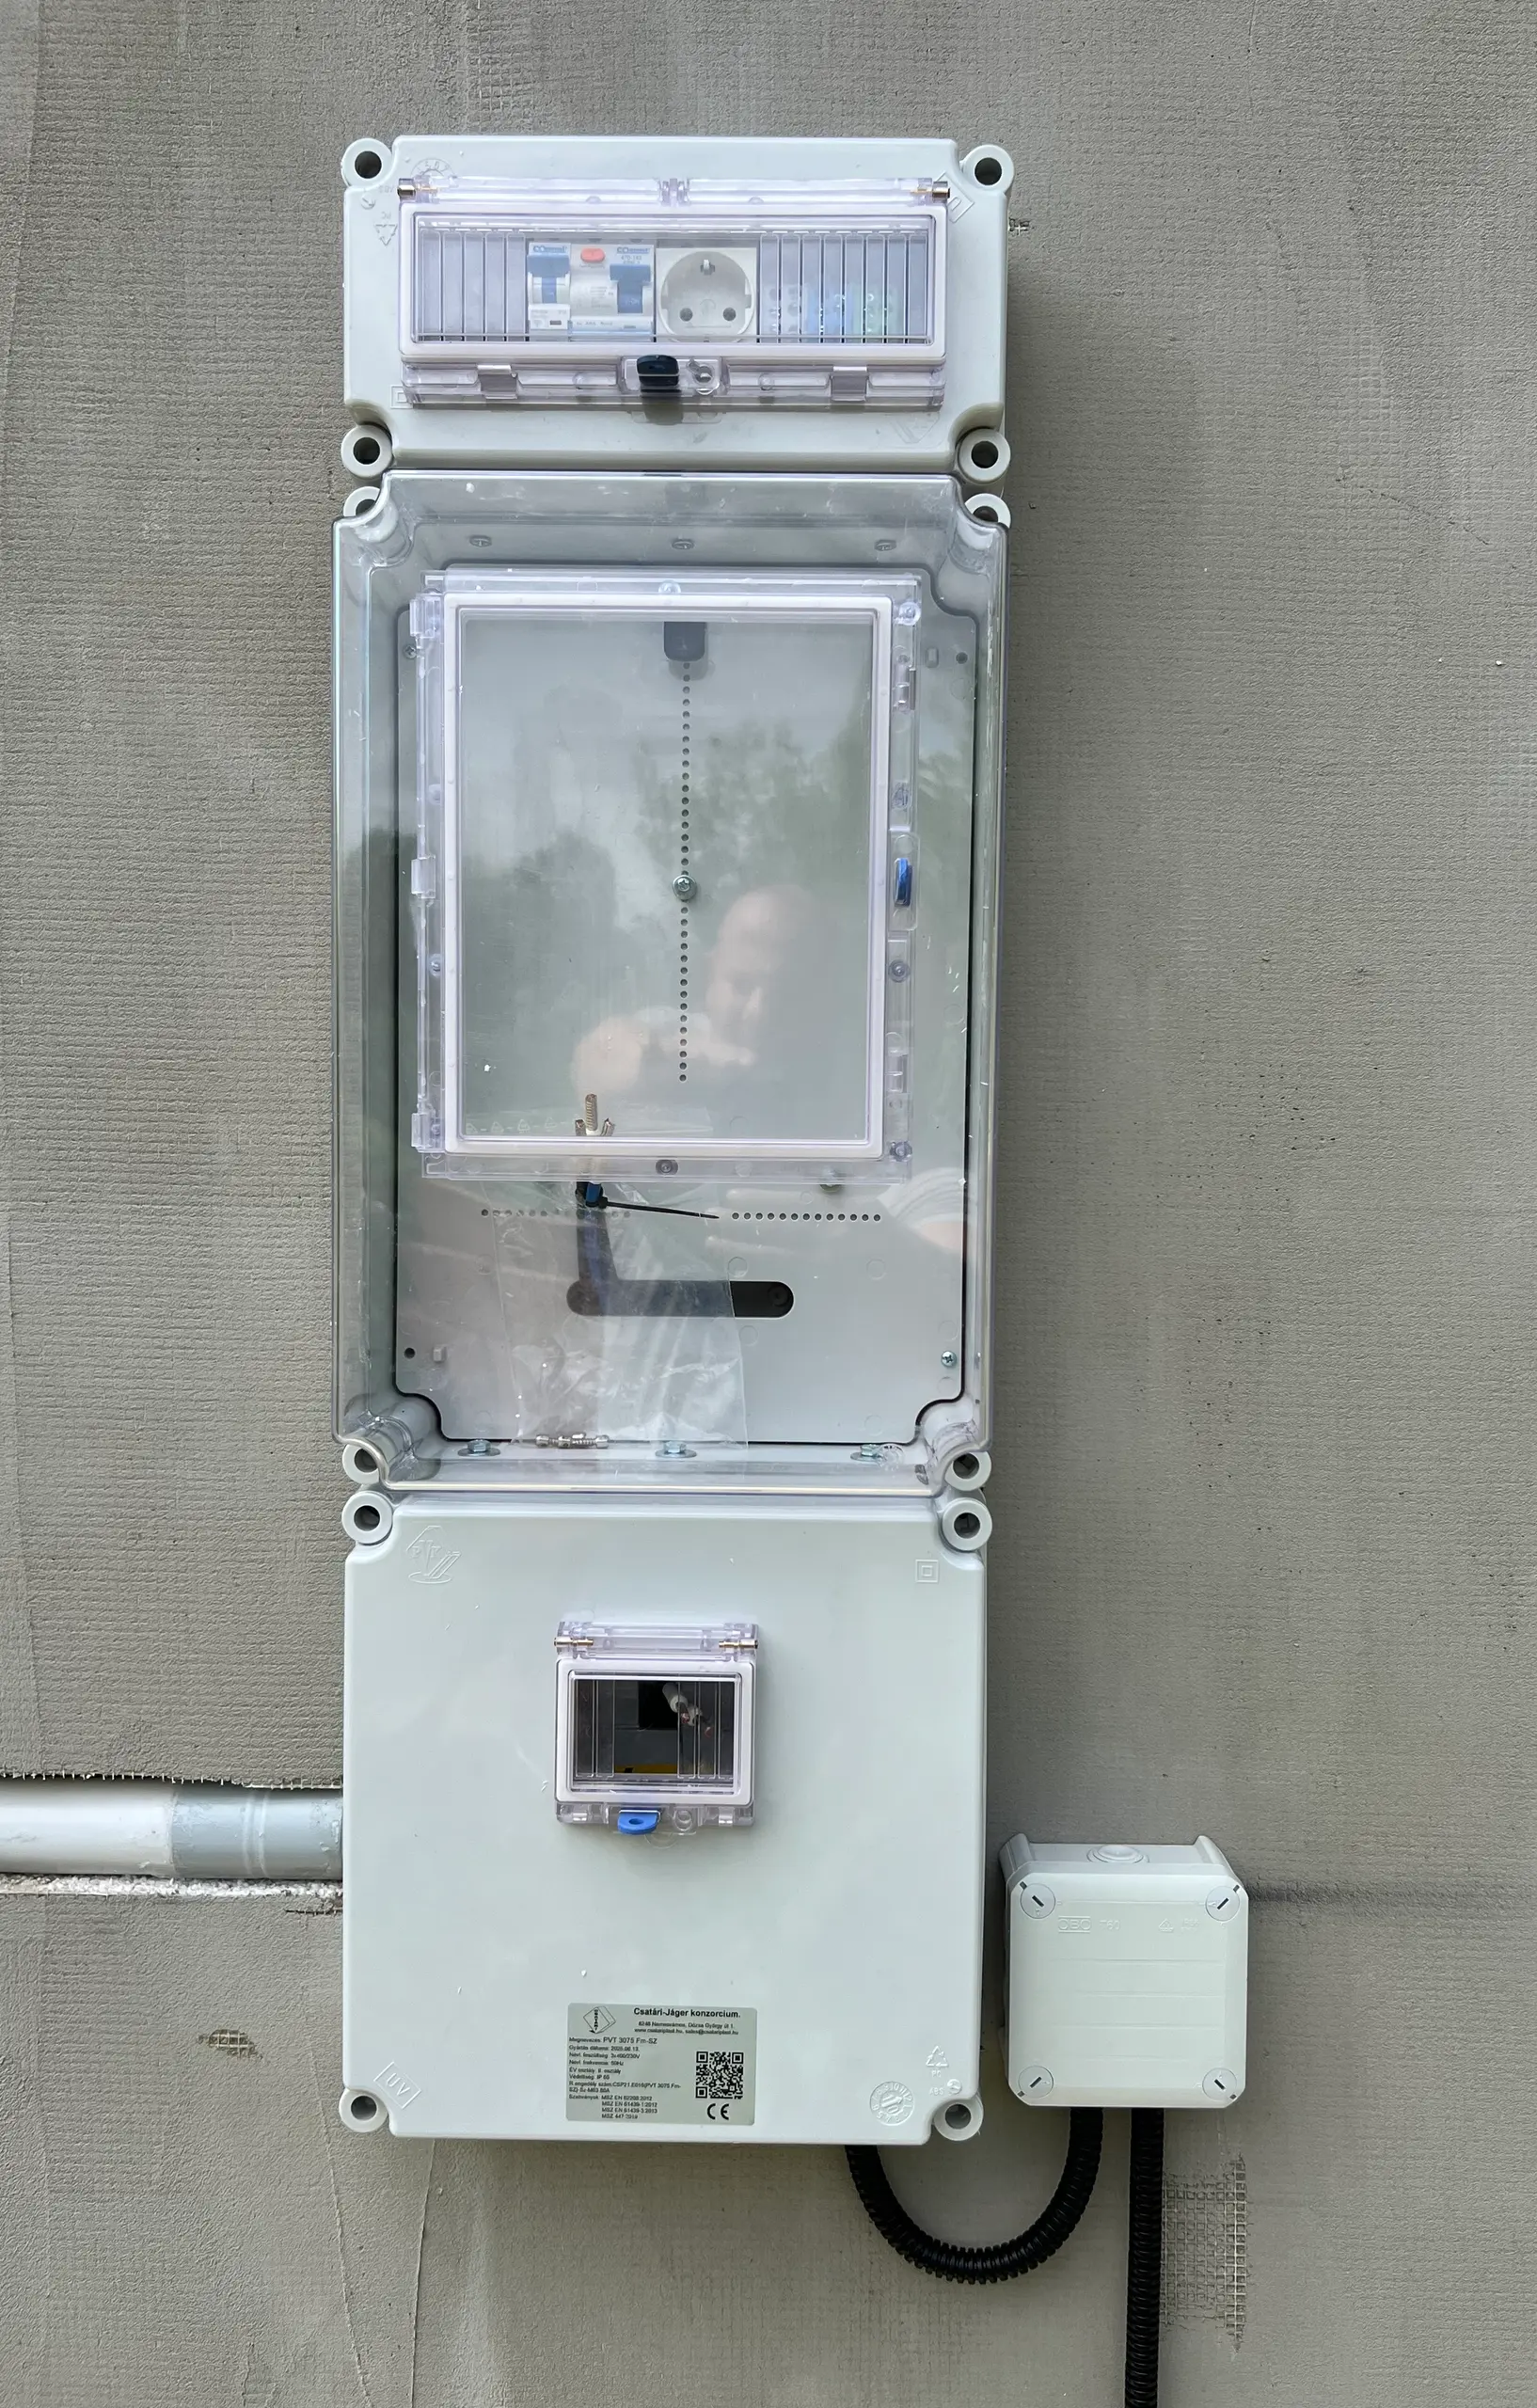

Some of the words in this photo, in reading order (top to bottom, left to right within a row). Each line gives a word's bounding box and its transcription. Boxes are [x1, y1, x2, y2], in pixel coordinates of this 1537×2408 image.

[633, 2007, 689, 2018] Csatári-Jáger
[690, 2008, 741, 2018] konzorcium.
[386, 2072, 411, 2097] UV
